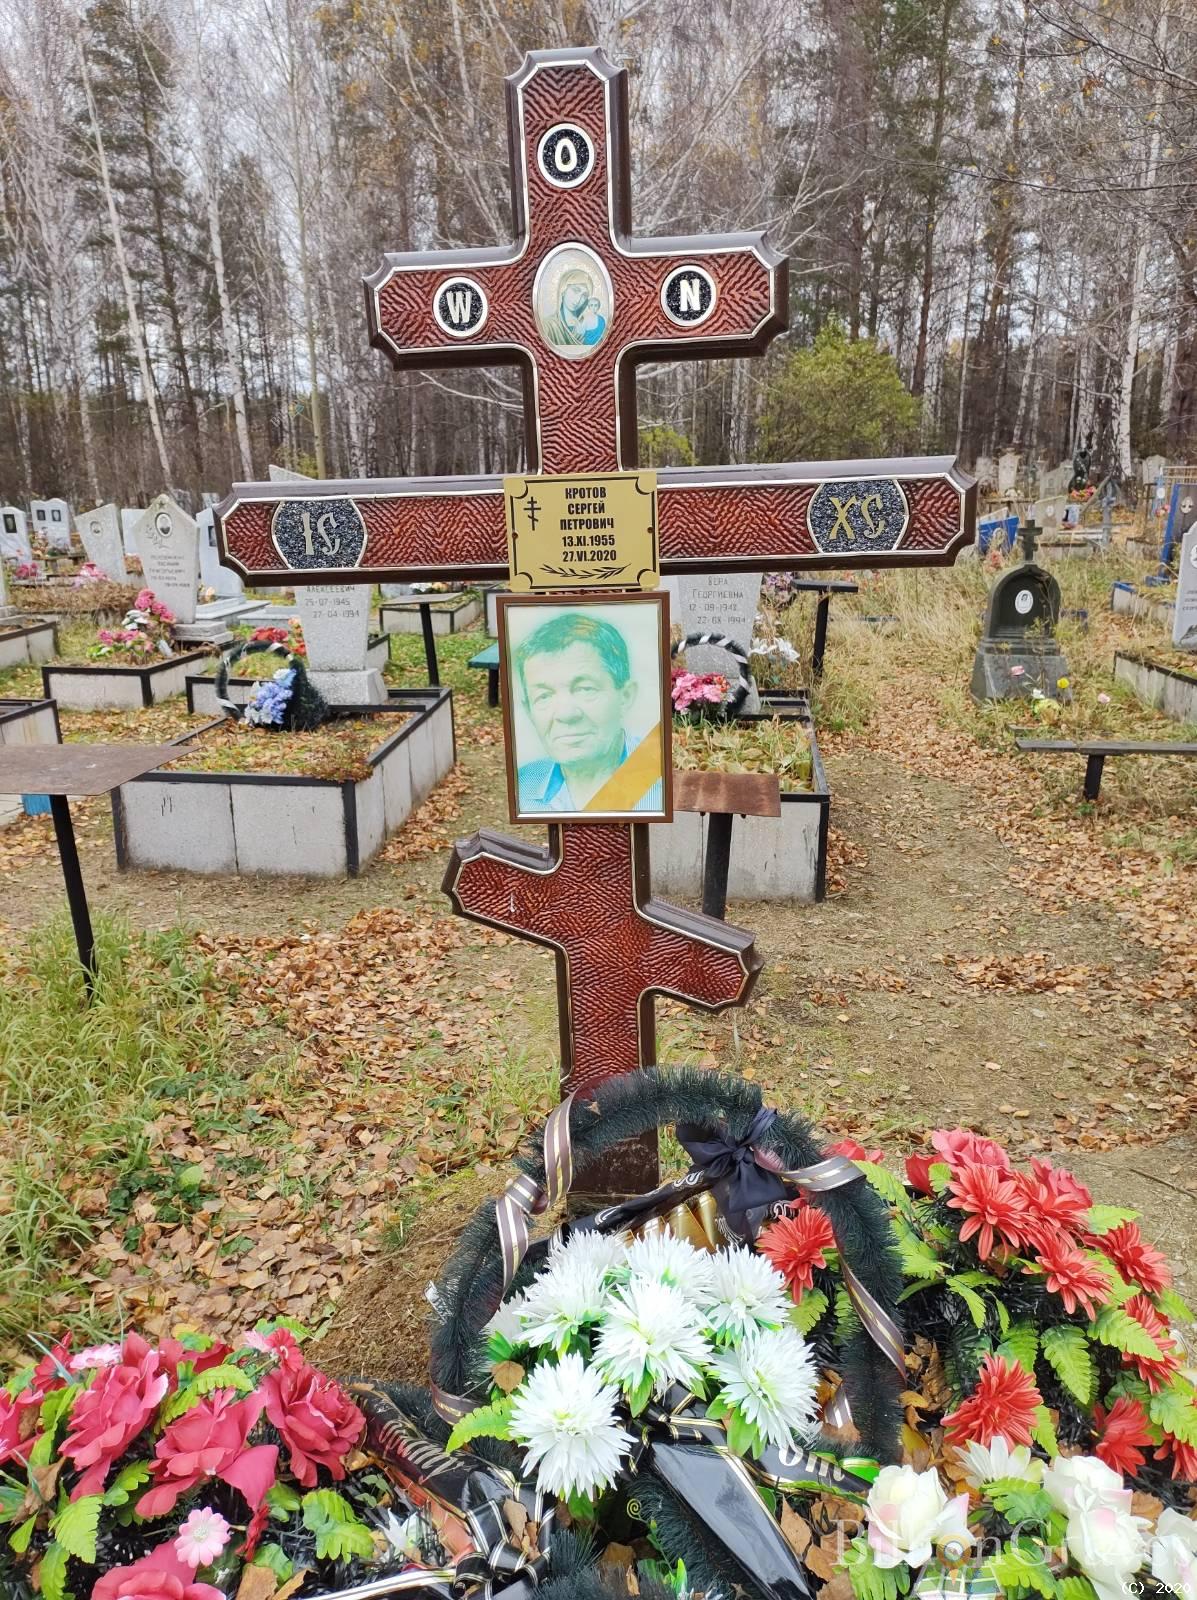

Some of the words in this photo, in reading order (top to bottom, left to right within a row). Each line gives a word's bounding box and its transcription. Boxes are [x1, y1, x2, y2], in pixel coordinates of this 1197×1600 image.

[565, 486, 607, 499] КРОТОВ
[567, 500, 605, 515] СЕРГЕЙ
[560, 517, 615, 531] ПЕТРОВИЧ
[562, 534, 616, 548] 13.XI.1955
[562, 549, 617, 563] 27.VI.2020
